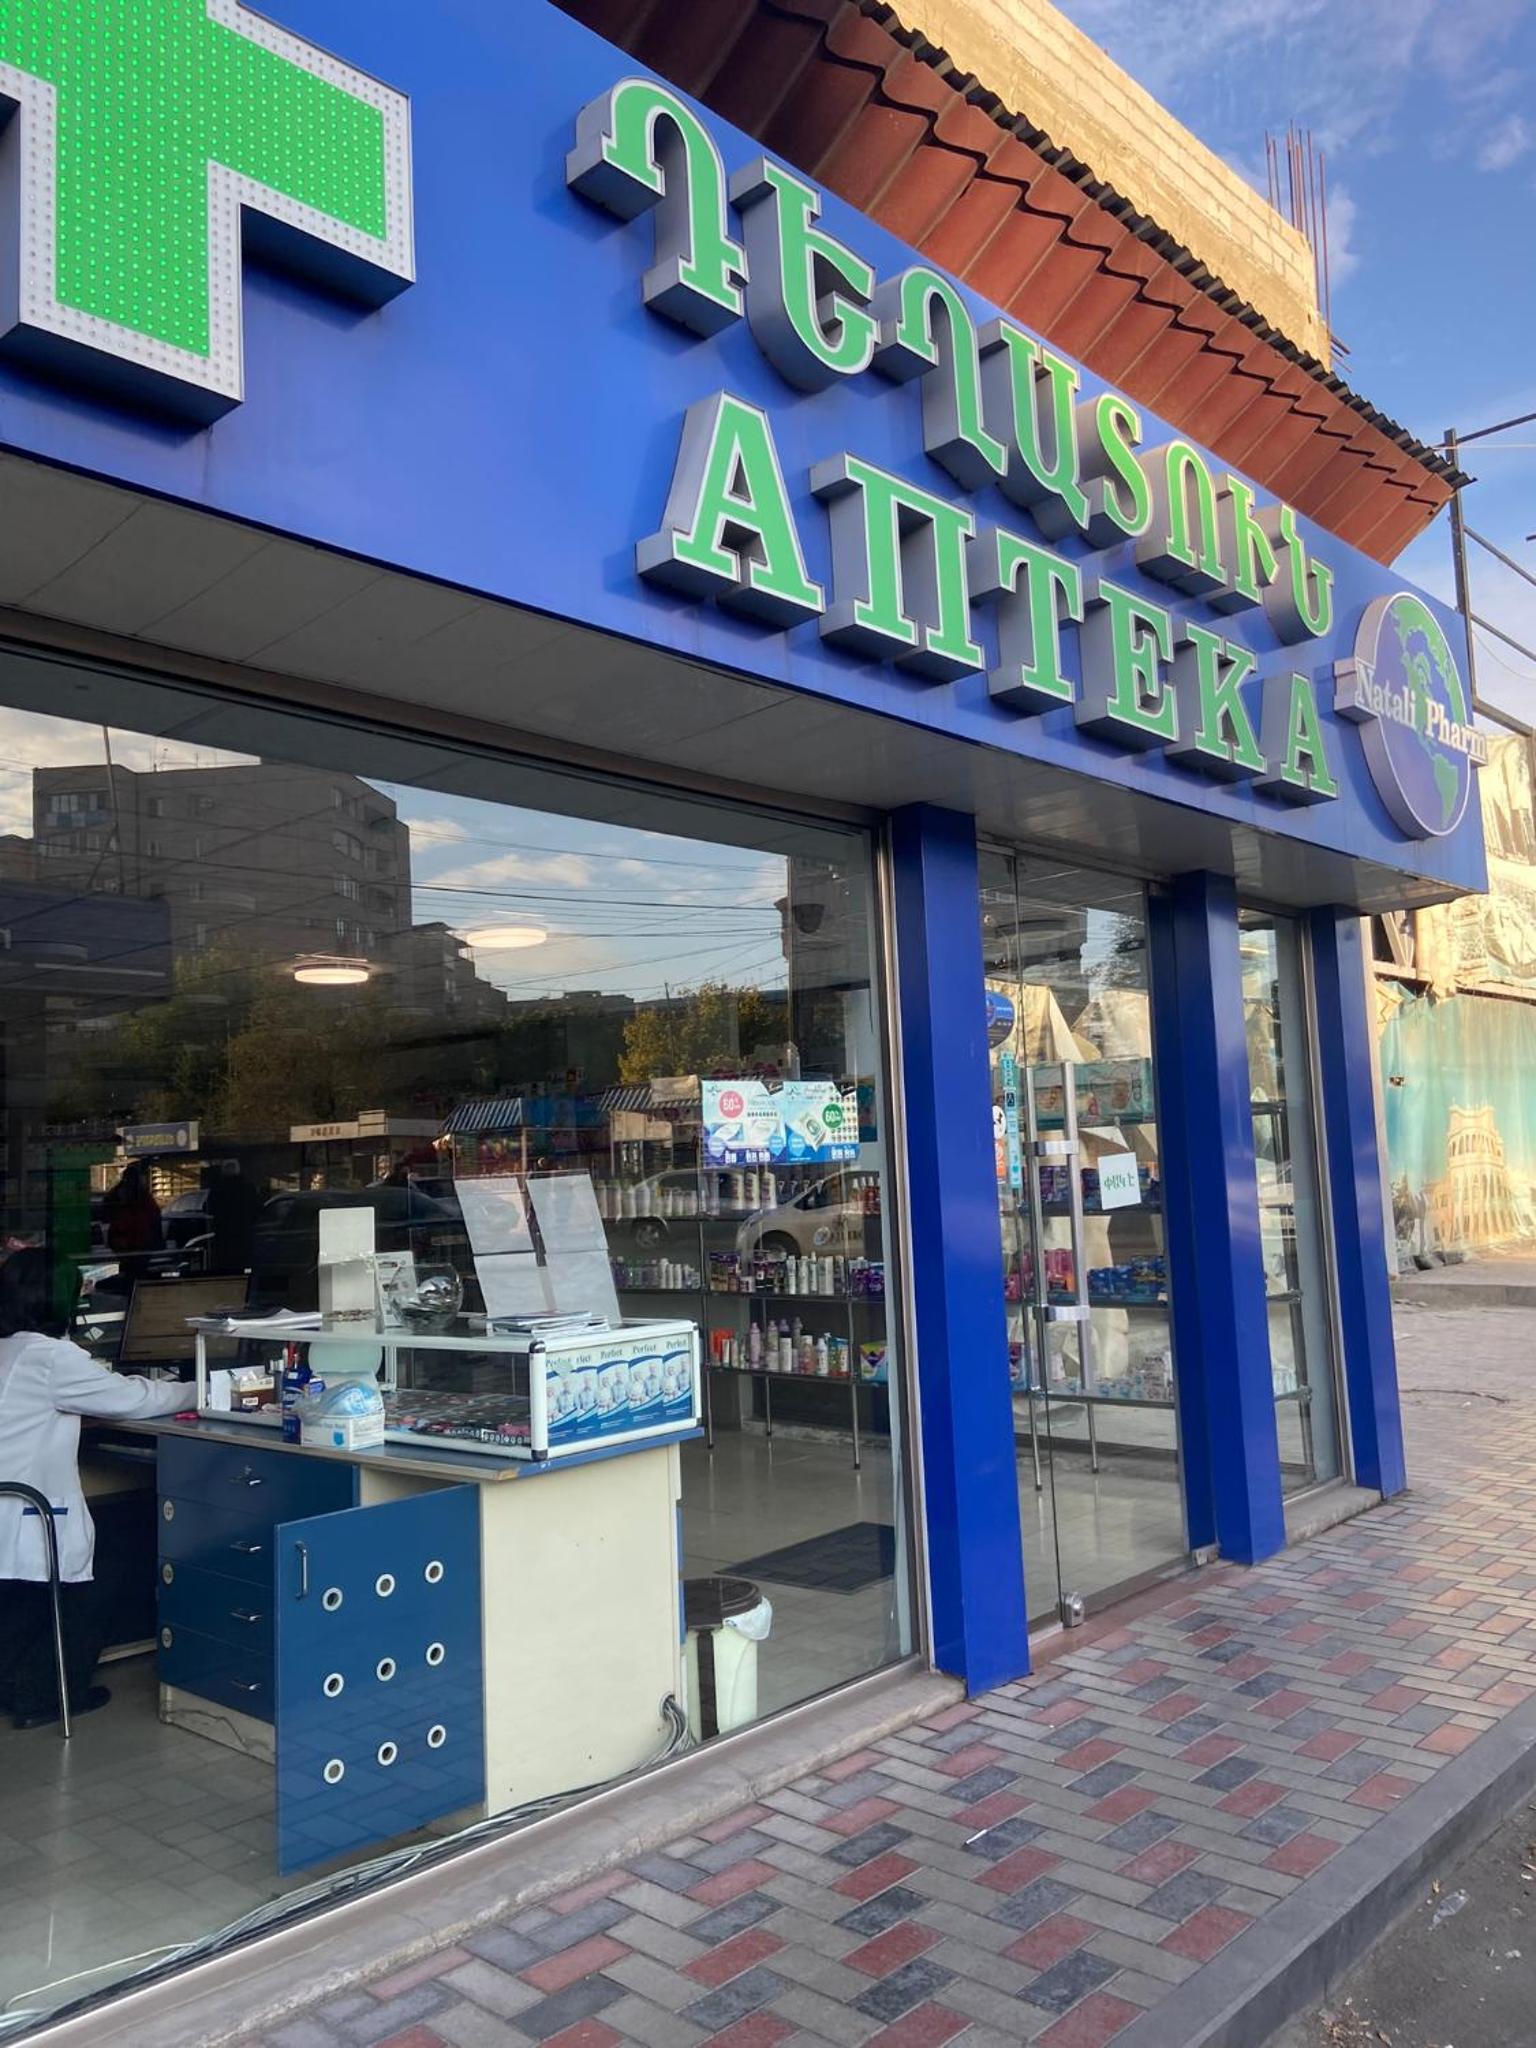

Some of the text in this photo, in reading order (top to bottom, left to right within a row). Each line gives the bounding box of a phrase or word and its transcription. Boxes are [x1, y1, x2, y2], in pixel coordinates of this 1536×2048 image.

[671, 389, 1339, 801] АПТЕКА
[1355, 661, 1487, 762] Natali Pharm
